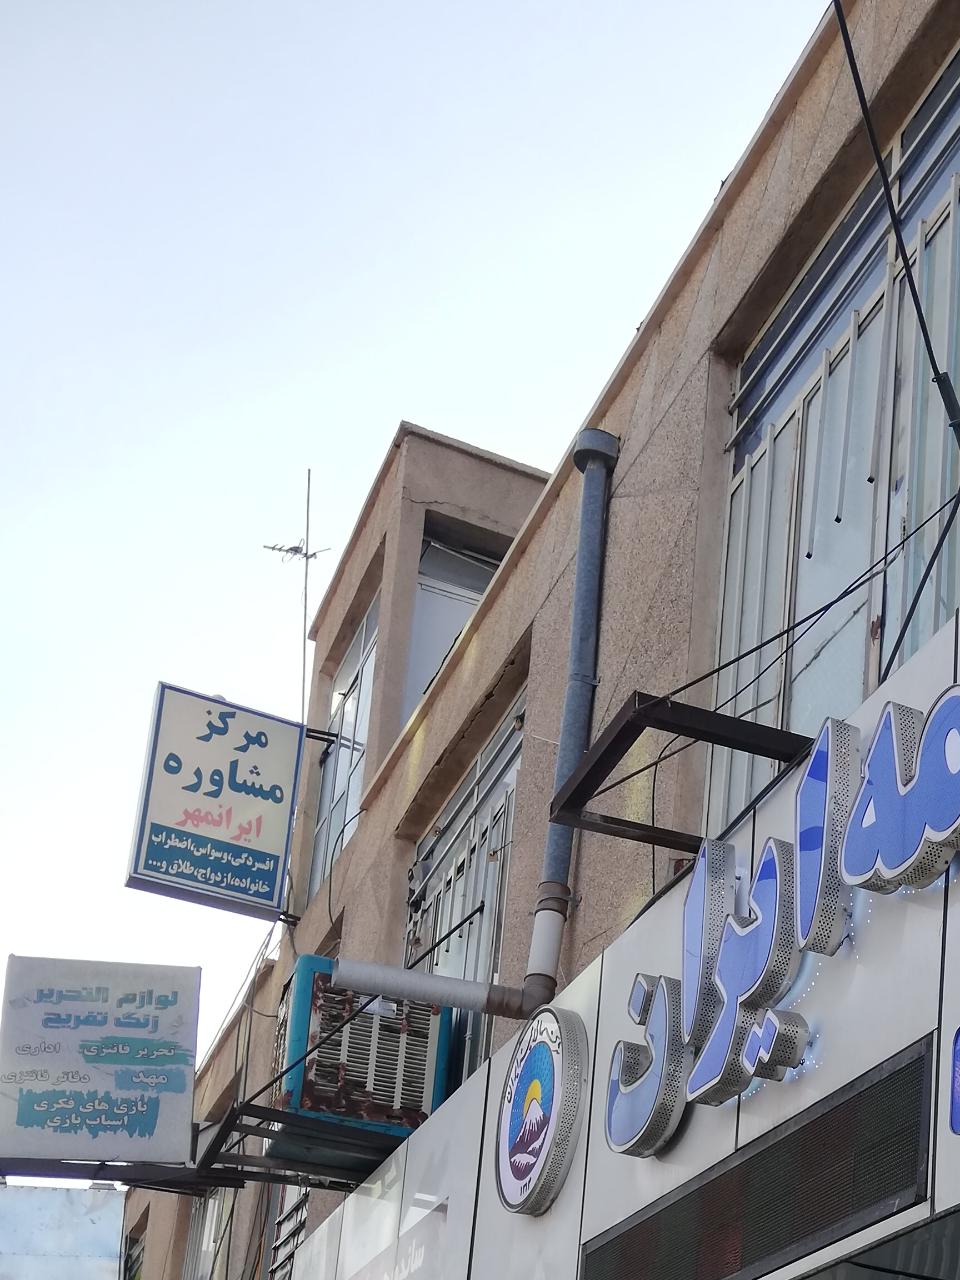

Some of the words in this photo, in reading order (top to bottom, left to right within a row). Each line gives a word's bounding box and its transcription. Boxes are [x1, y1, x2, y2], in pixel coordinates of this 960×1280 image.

[196, 709, 269, 752] مرکز
[163, 752, 285, 804] مشاوره
[604, 718, 859, 1158] ایران
[116, 988, 178, 1010] لوازم
[114, 1012, 159, 1033] زنگ
[131, 1071, 168, 1087] مهد
[33, 1097, 75, 1111] فکری
[79, 1099, 109, 1112] های
[113, 1098, 148, 1114] بازی
[46, 1112, 81, 1128] بازی
[86, 1114, 128, 1126] اسباب
